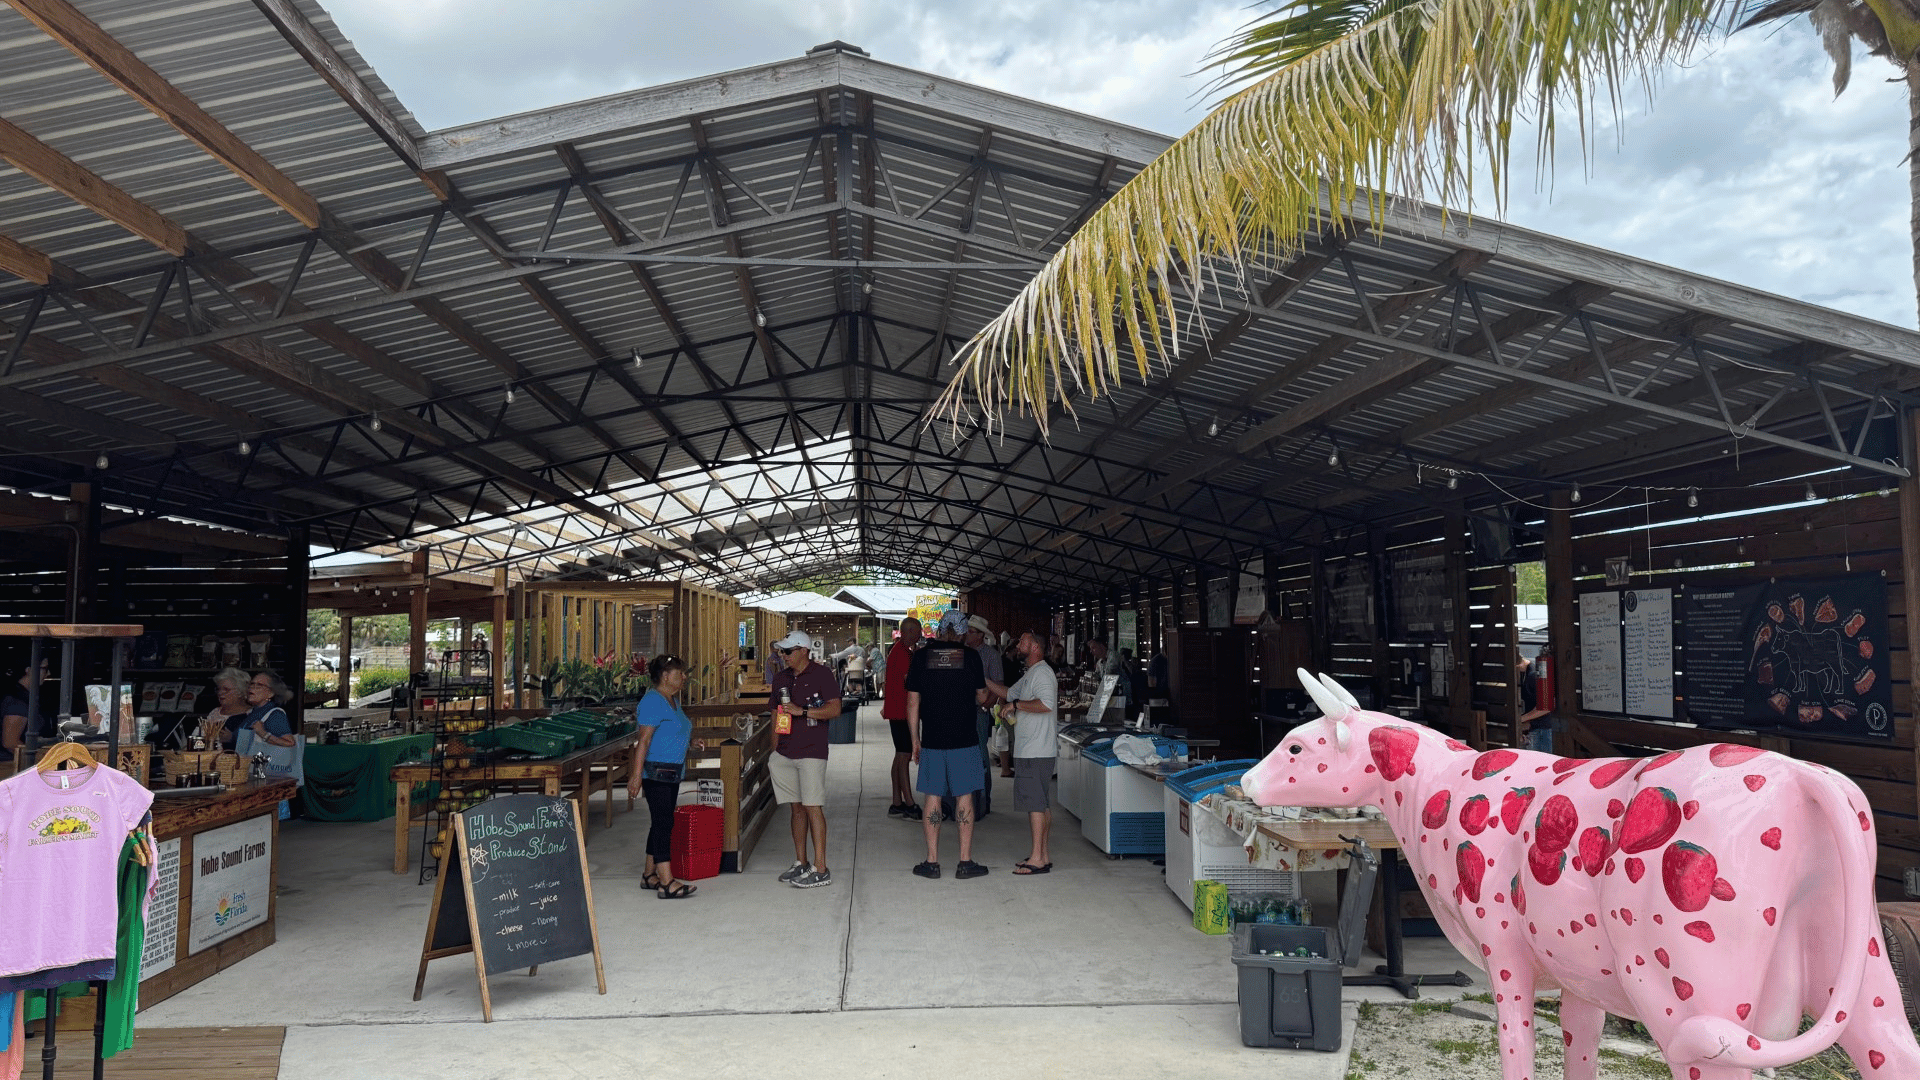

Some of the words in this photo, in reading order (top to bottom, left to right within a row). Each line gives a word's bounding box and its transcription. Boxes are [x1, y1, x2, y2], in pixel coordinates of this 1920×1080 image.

[28, 807, 62, 831] HOBE
[63, 806, 101, 823] SOUND
[469, 814, 504, 840] Hobe
[504, 811, 536, 838] Sound
[536, 806, 564, 830] Farms
[201, 856, 219, 876] Hobe
[221, 845, 243, 870] Sound
[244, 841, 266, 862] Farms
[489, 840, 526, 860] Produce
[526, 834, 568, 860] Stand
[233, 890, 246, 904] Fresh
[230, 904, 248, 918] Florida
[515, 939, 538, 950] more
